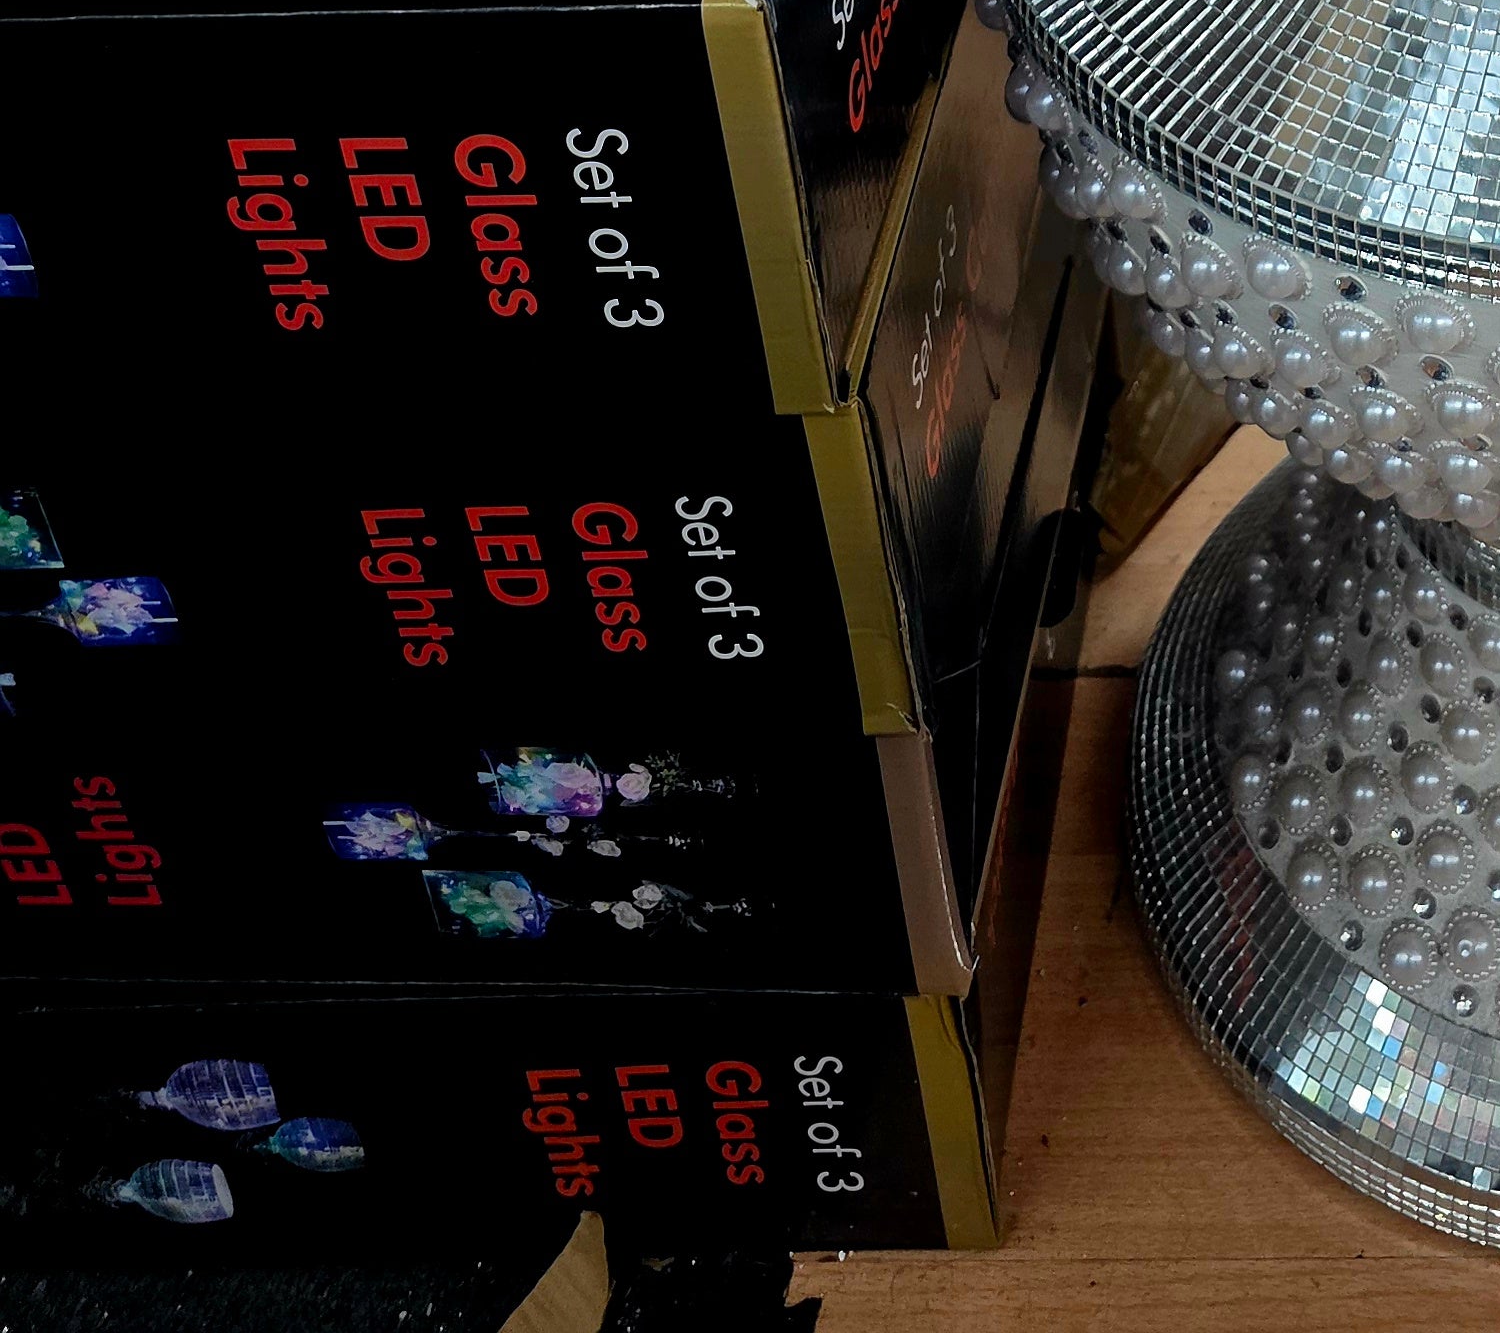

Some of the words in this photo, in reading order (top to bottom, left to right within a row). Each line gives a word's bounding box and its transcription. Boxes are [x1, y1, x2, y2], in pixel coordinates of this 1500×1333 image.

[338, 136, 431, 262] LED
[565, 127, 633, 209] Set
[226, 138, 329, 331] Lights
[453, 134, 539, 318] Glass
[588, 227, 660, 284] of
[603, 298, 665, 328] 3
[912, 311, 933, 410] Set
[464, 505, 551, 607] LED
[674, 495, 736, 560] Set
[359, 508, 454, 667] Lights
[571, 501, 649, 653] Glass
[694, 575, 762, 626] of
[707, 633, 765, 660] 3
[0, 823, 73, 905] LED
[72, 776, 163, 906] Lights
[615, 1064, 684, 1149] LED
[705, 1060, 769, 1185] Glass
[793, 1055, 844, 1115] Set
[522, 1069, 600, 1197] Lights
[807, 1122, 861, 1168] of
[816, 1171, 865, 1192] 3
